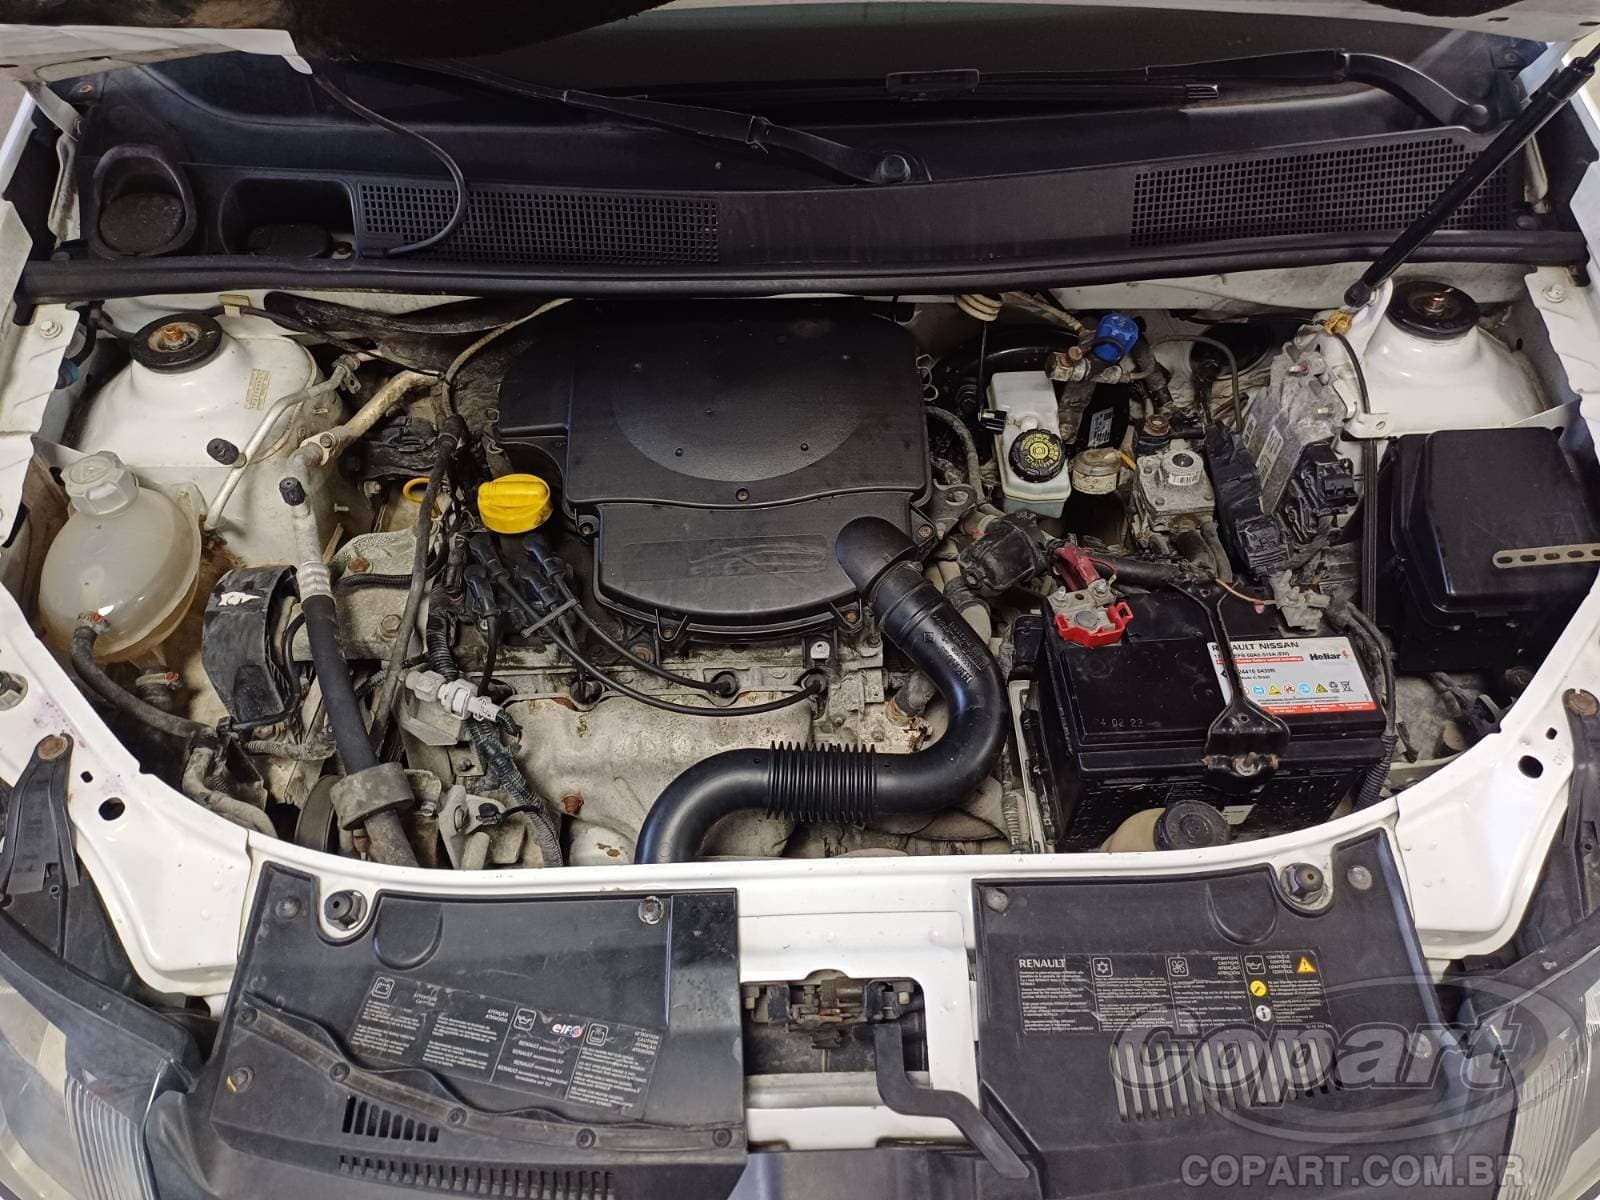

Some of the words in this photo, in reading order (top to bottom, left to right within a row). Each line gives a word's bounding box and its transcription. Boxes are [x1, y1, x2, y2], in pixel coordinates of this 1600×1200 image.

[1212, 643, 1256, 652] RAULT
[1259, 641, 1299, 650] NISSAN
[1309, 653, 1341, 661] Heliar
[1018, 958, 1065, 968] RENAULT
